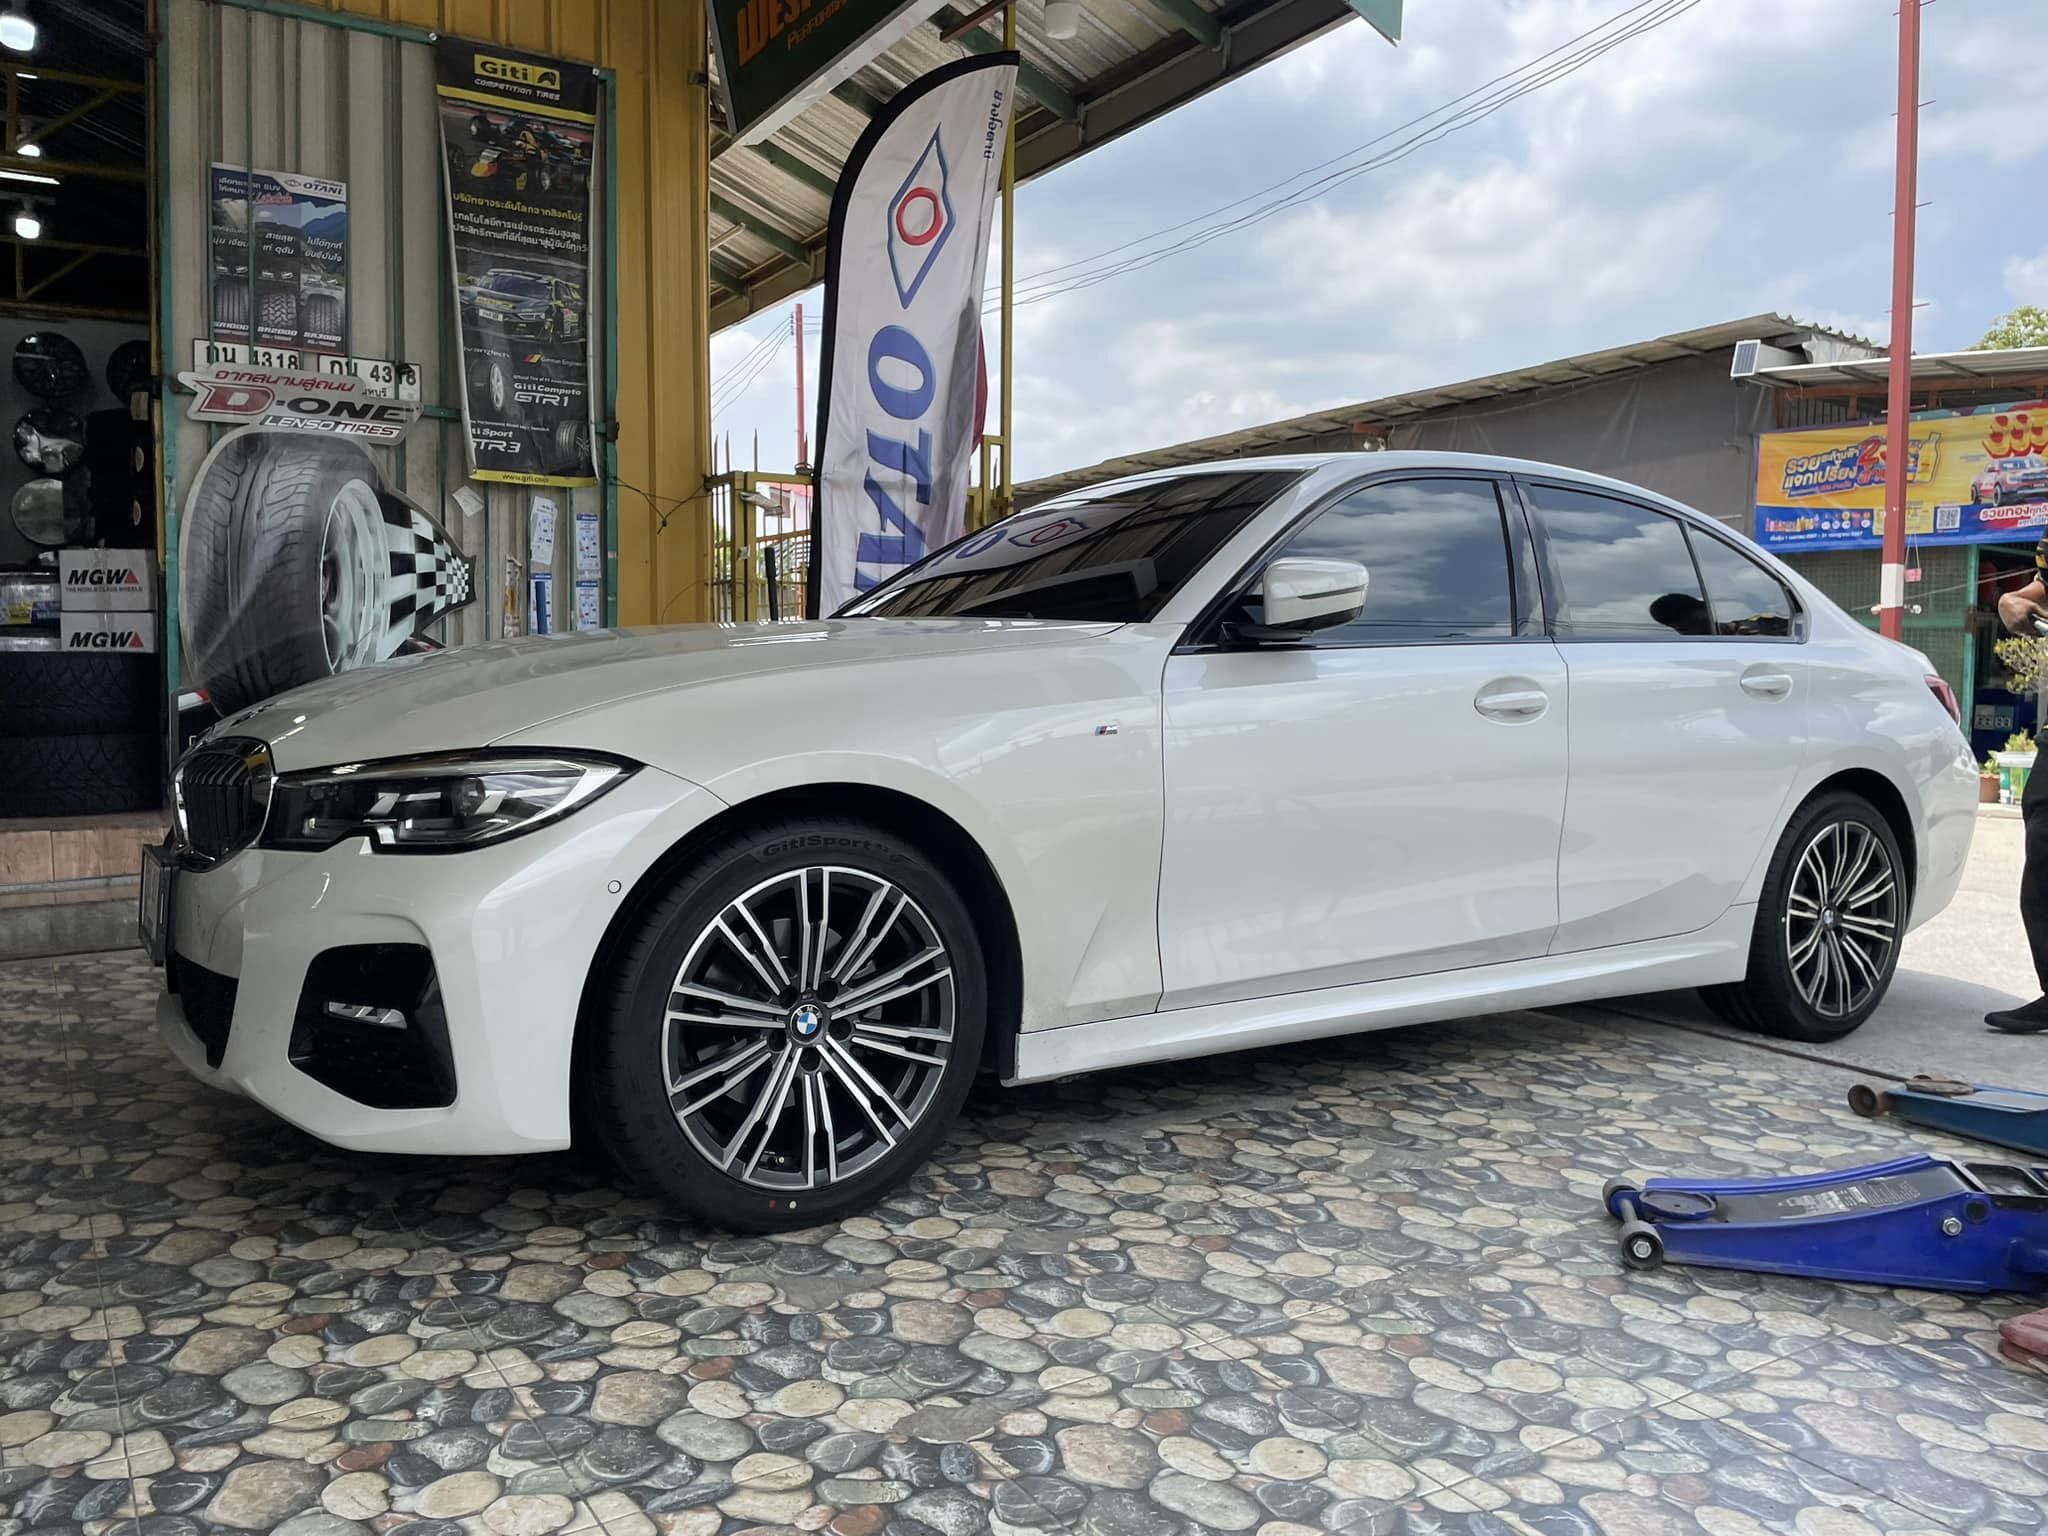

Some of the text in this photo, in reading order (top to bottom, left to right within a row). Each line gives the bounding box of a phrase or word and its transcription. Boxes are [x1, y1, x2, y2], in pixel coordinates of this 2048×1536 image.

[737, 0, 812, 65] WES
[480, 61, 528, 81] Giti
[536, 90, 561, 101] TIRES
[303, 182, 343, 195] OTANI
[215, 369, 355, 393] จากสนามสู่ถนน
[198, 381, 409, 422] D-ONE
[854, 325, 936, 592] OTA
[68, 569, 128, 585] MGW
[69, 631, 133, 648] MGW
